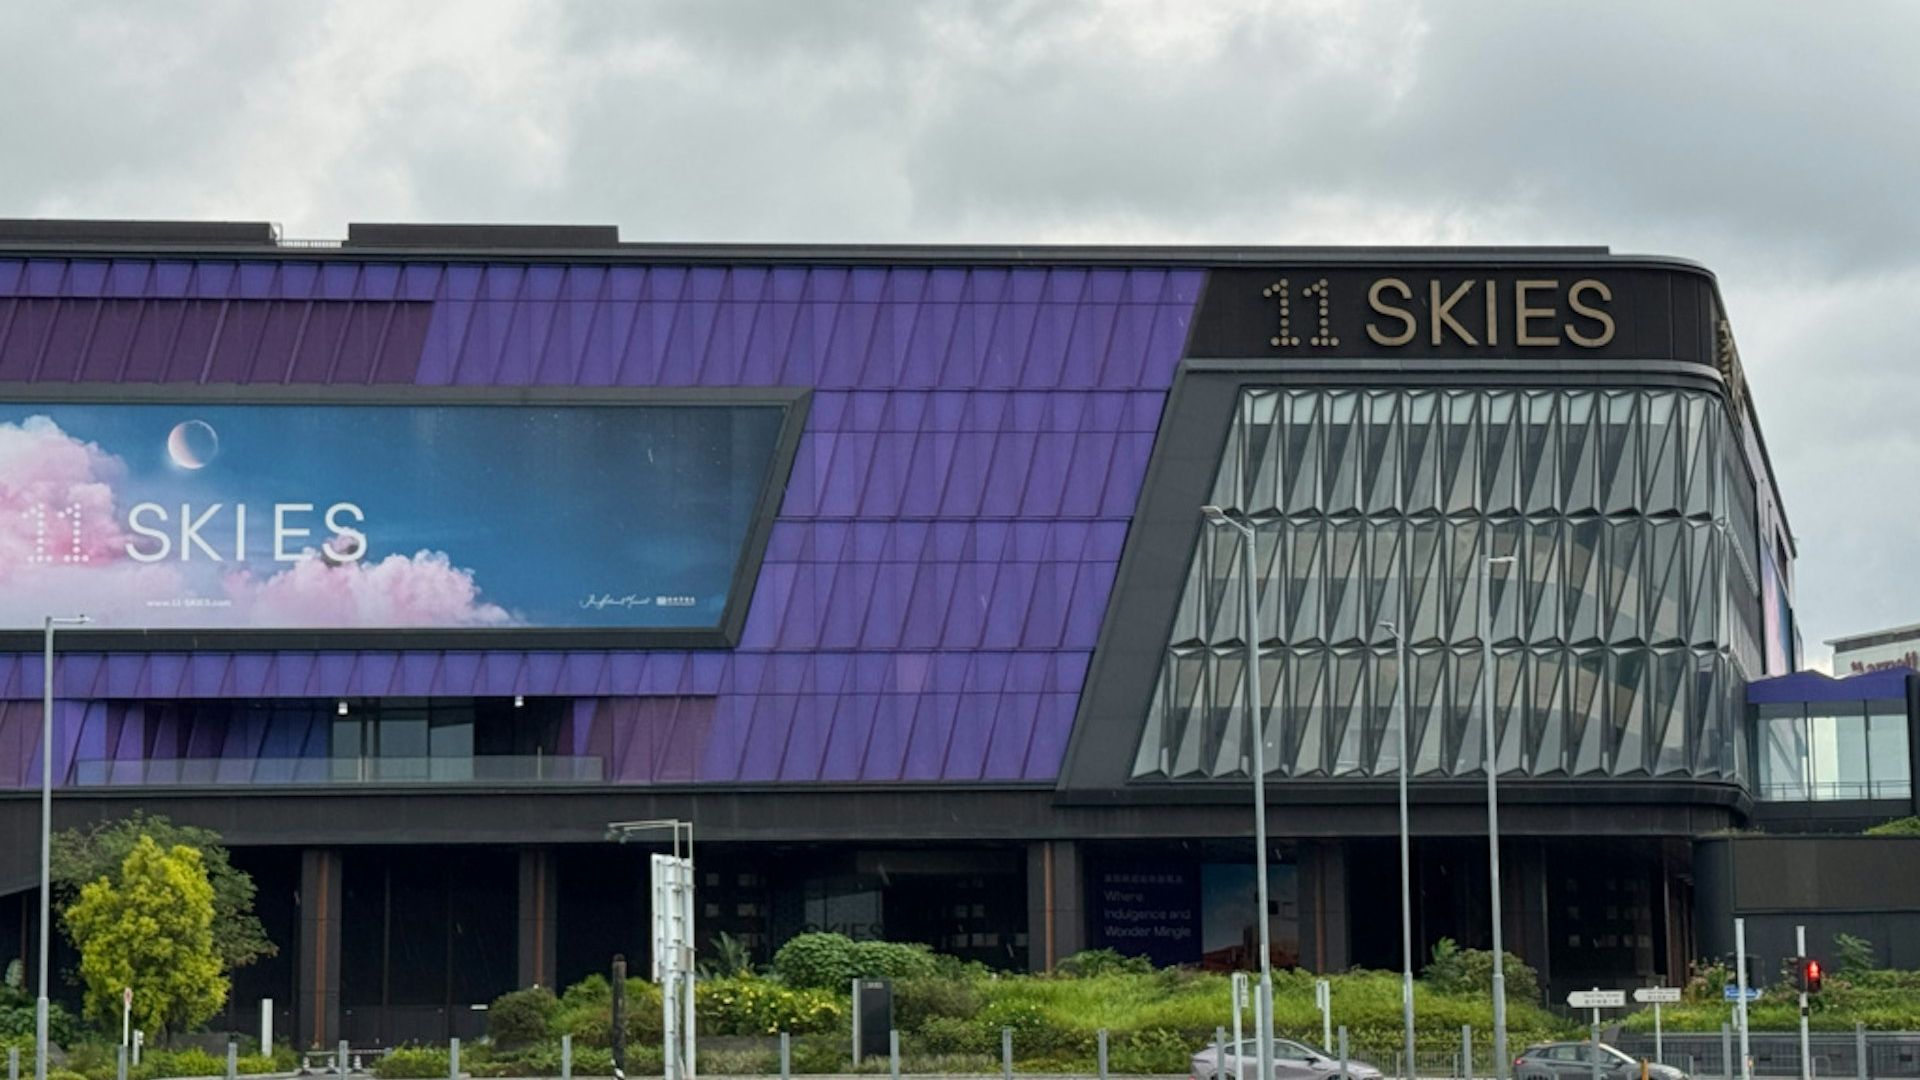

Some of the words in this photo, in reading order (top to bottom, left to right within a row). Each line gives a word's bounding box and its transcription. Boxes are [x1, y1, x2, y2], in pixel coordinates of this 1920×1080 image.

[1262, 277, 1340, 348] 11
[1365, 277, 1617, 348] SKIES
[21, 502, 90, 564] 11
[125, 502, 368, 563] SKIES
[1103, 890, 1143, 902] Where
[1103, 909, 1166, 922] Indulgence
[1169, 909, 1191, 920] and
[1103, 925, 1151, 937] Wonder
[1153, 925, 1191, 940] Mingle
